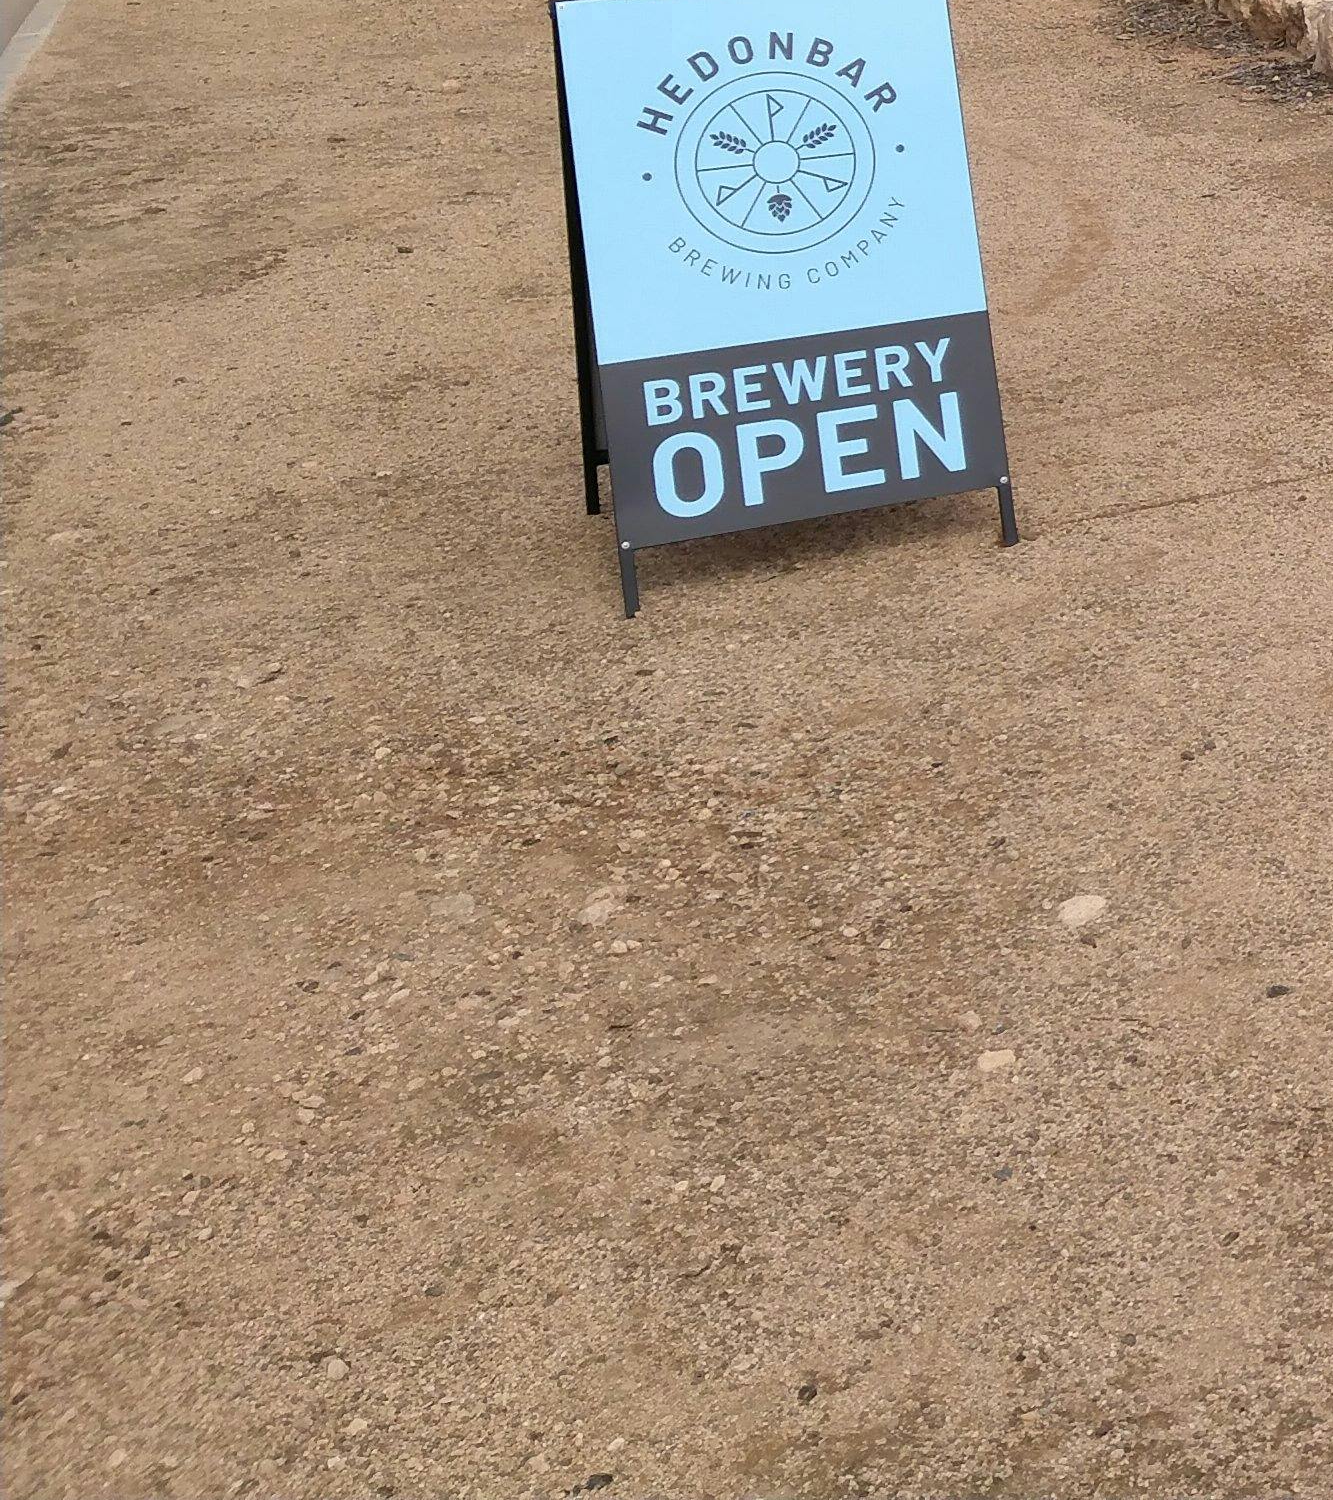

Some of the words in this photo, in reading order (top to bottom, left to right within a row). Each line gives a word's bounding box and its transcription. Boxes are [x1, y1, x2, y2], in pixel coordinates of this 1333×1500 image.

[636, 31, 898, 136] HEDONBAR
[668, 236, 791, 290] BREWING
[806, 196, 906, 284] COMPANY
[643, 337, 951, 427] BREWERY
[652, 391, 967, 518] OPEN
